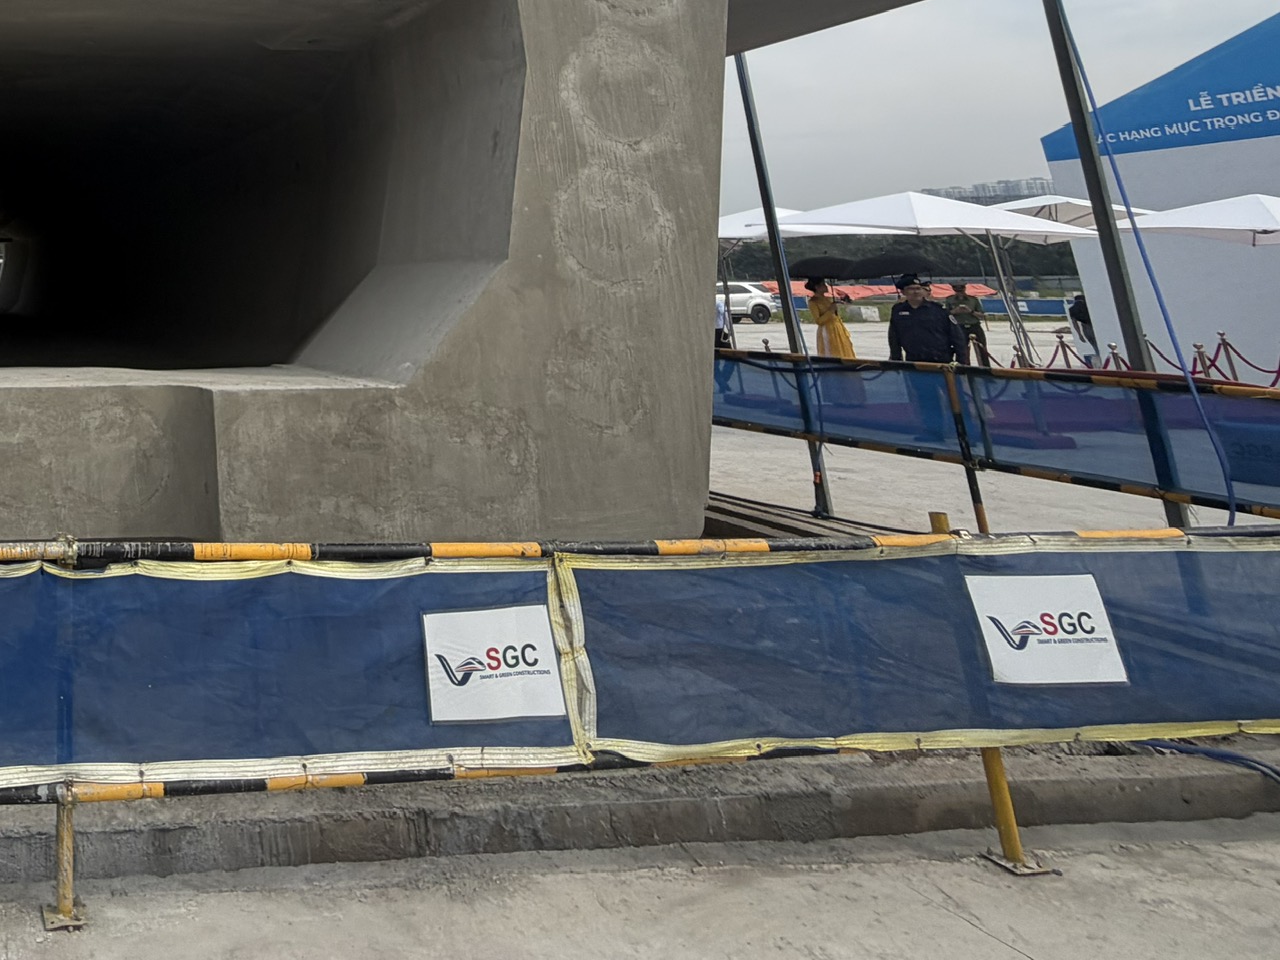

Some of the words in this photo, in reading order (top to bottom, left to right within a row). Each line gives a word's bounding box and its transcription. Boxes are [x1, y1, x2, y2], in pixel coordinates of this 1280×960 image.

[1188, 91, 1215, 111] LỄ
[1118, 127, 1162, 142] HẠNG
[1164, 120, 1201, 136] MỤC
[1202, 112, 1264, 130] TRỌNG
[1039, 611, 1096, 636] SGC
[485, 643, 539, 671] SGC
